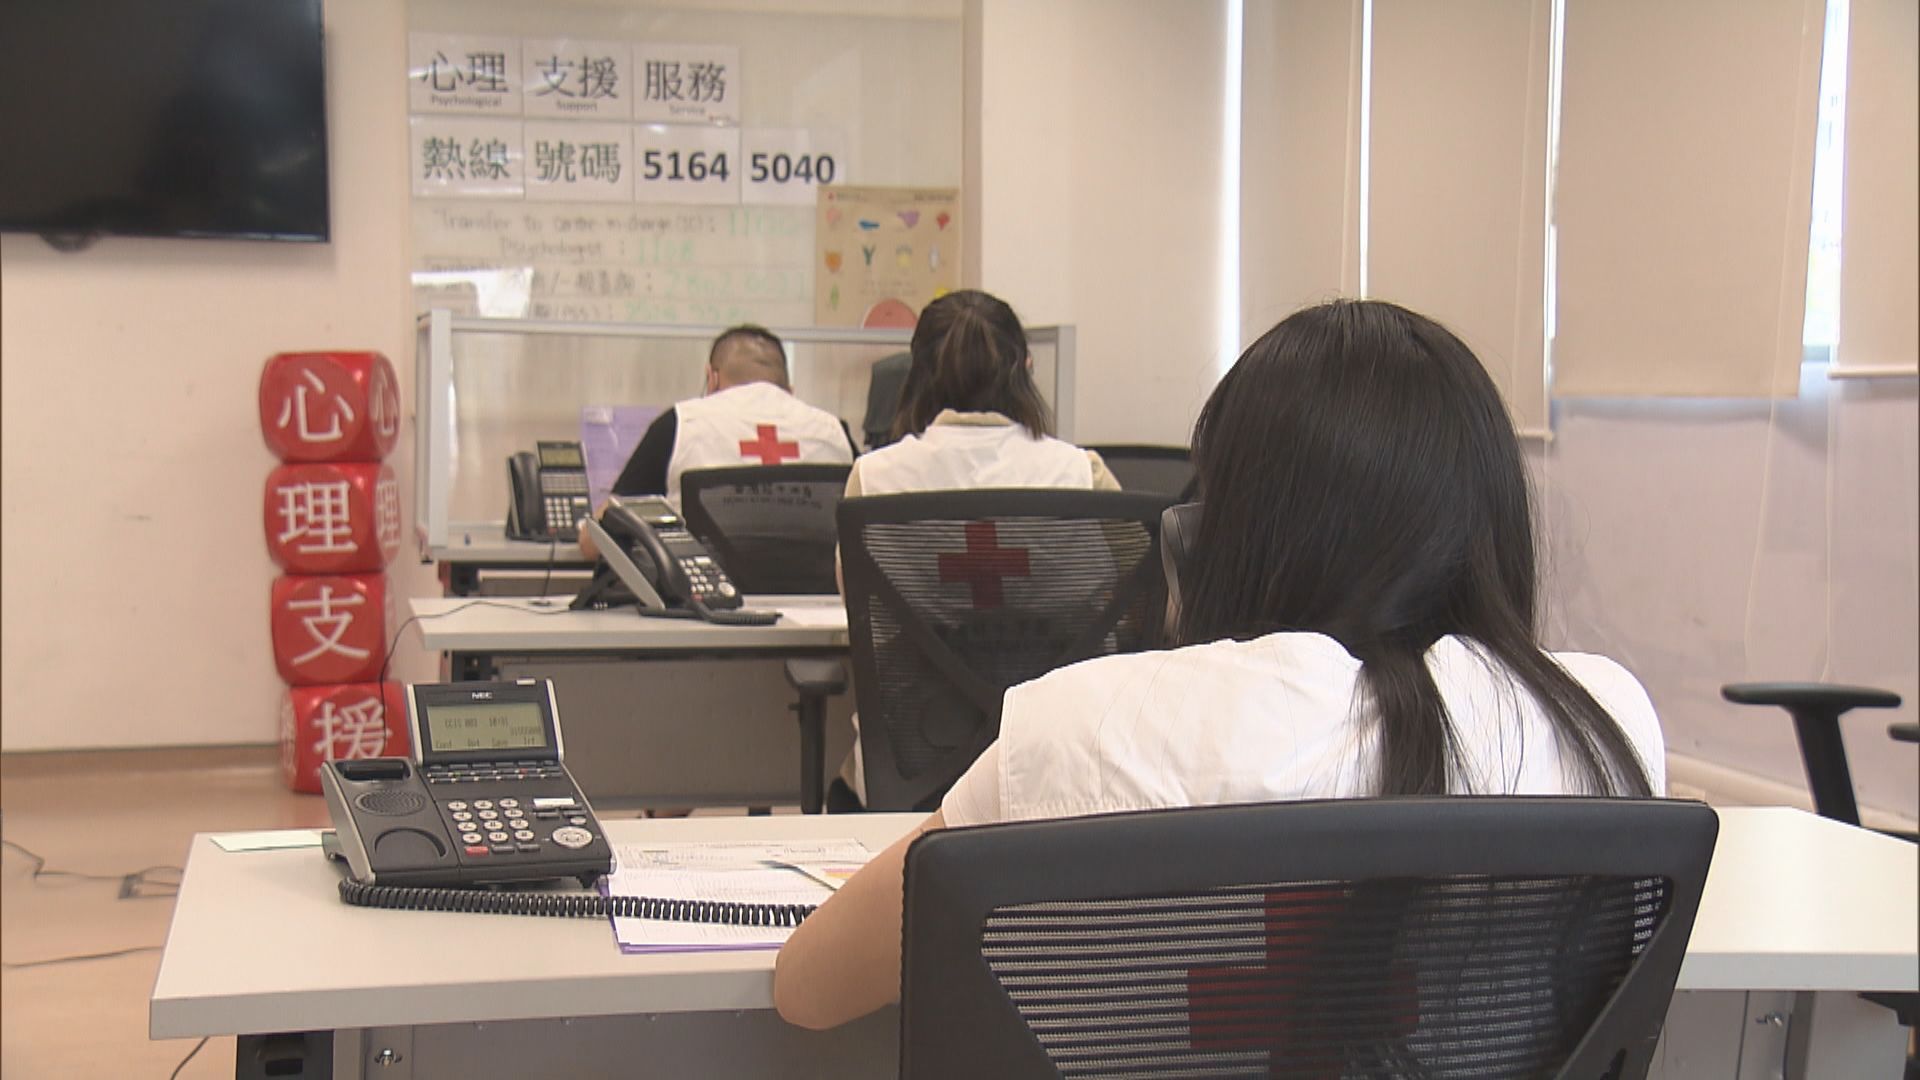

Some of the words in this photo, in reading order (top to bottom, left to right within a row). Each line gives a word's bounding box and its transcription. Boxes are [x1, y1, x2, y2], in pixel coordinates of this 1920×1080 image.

[421, 51, 509, 94] 心理
[534, 55, 619, 99] 支援
[644, 60, 727, 102] 服務
[556, 99, 598, 113] Support
[423, 136, 510, 181] 熱線
[535, 141, 621, 183] 號碼
[644, 150, 730, 182] 5164
[751, 154, 836, 185] 5040
[471, 691, 493, 700] NEC
